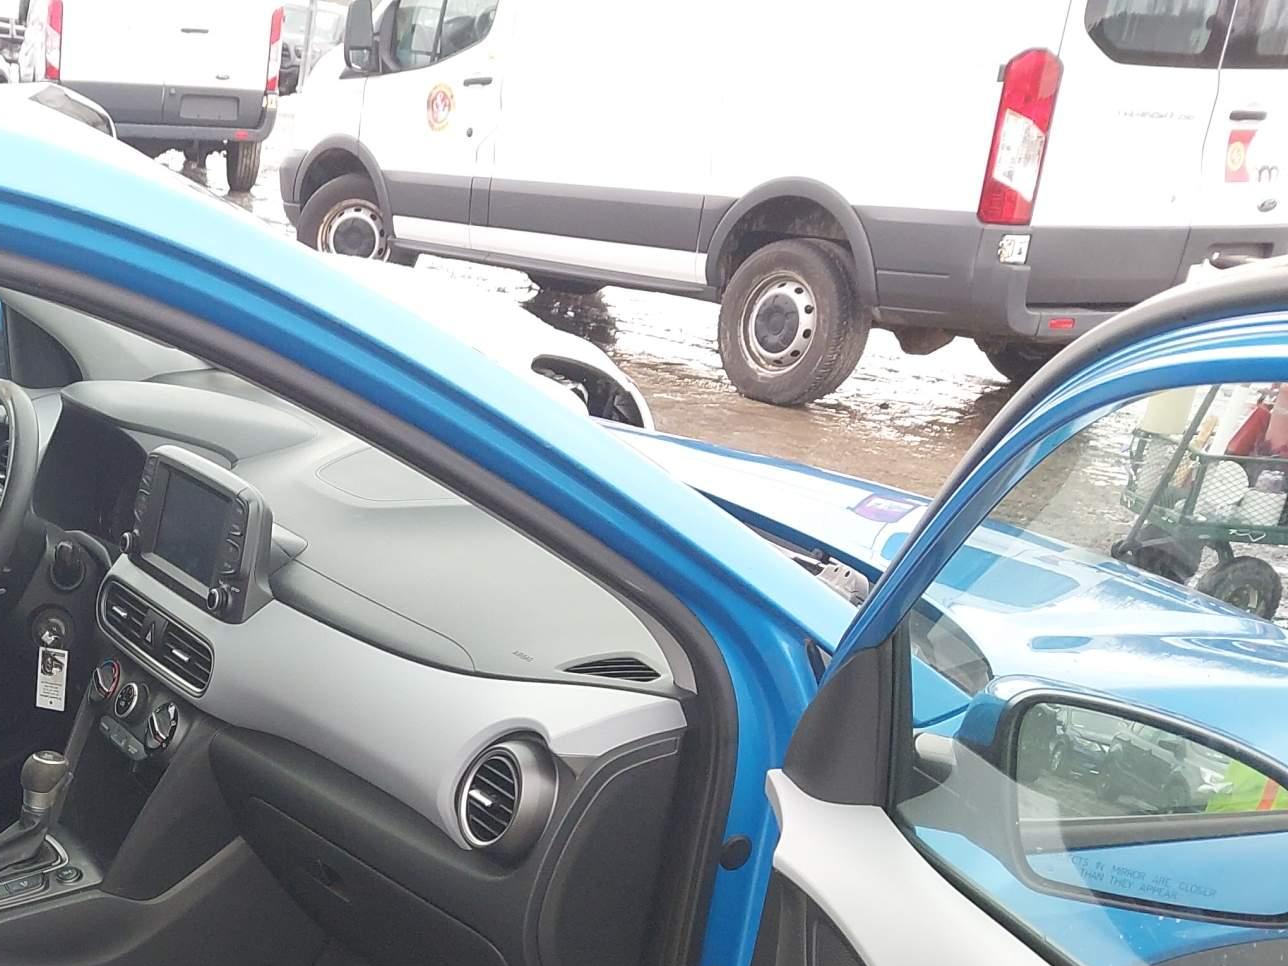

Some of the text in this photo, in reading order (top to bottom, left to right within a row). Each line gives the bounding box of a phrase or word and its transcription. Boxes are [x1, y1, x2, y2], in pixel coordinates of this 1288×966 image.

[1080, 867, 1105, 881] THAN
[1110, 875, 1133, 889] THEY
[1178, 880, 1217, 899] CLOSER
